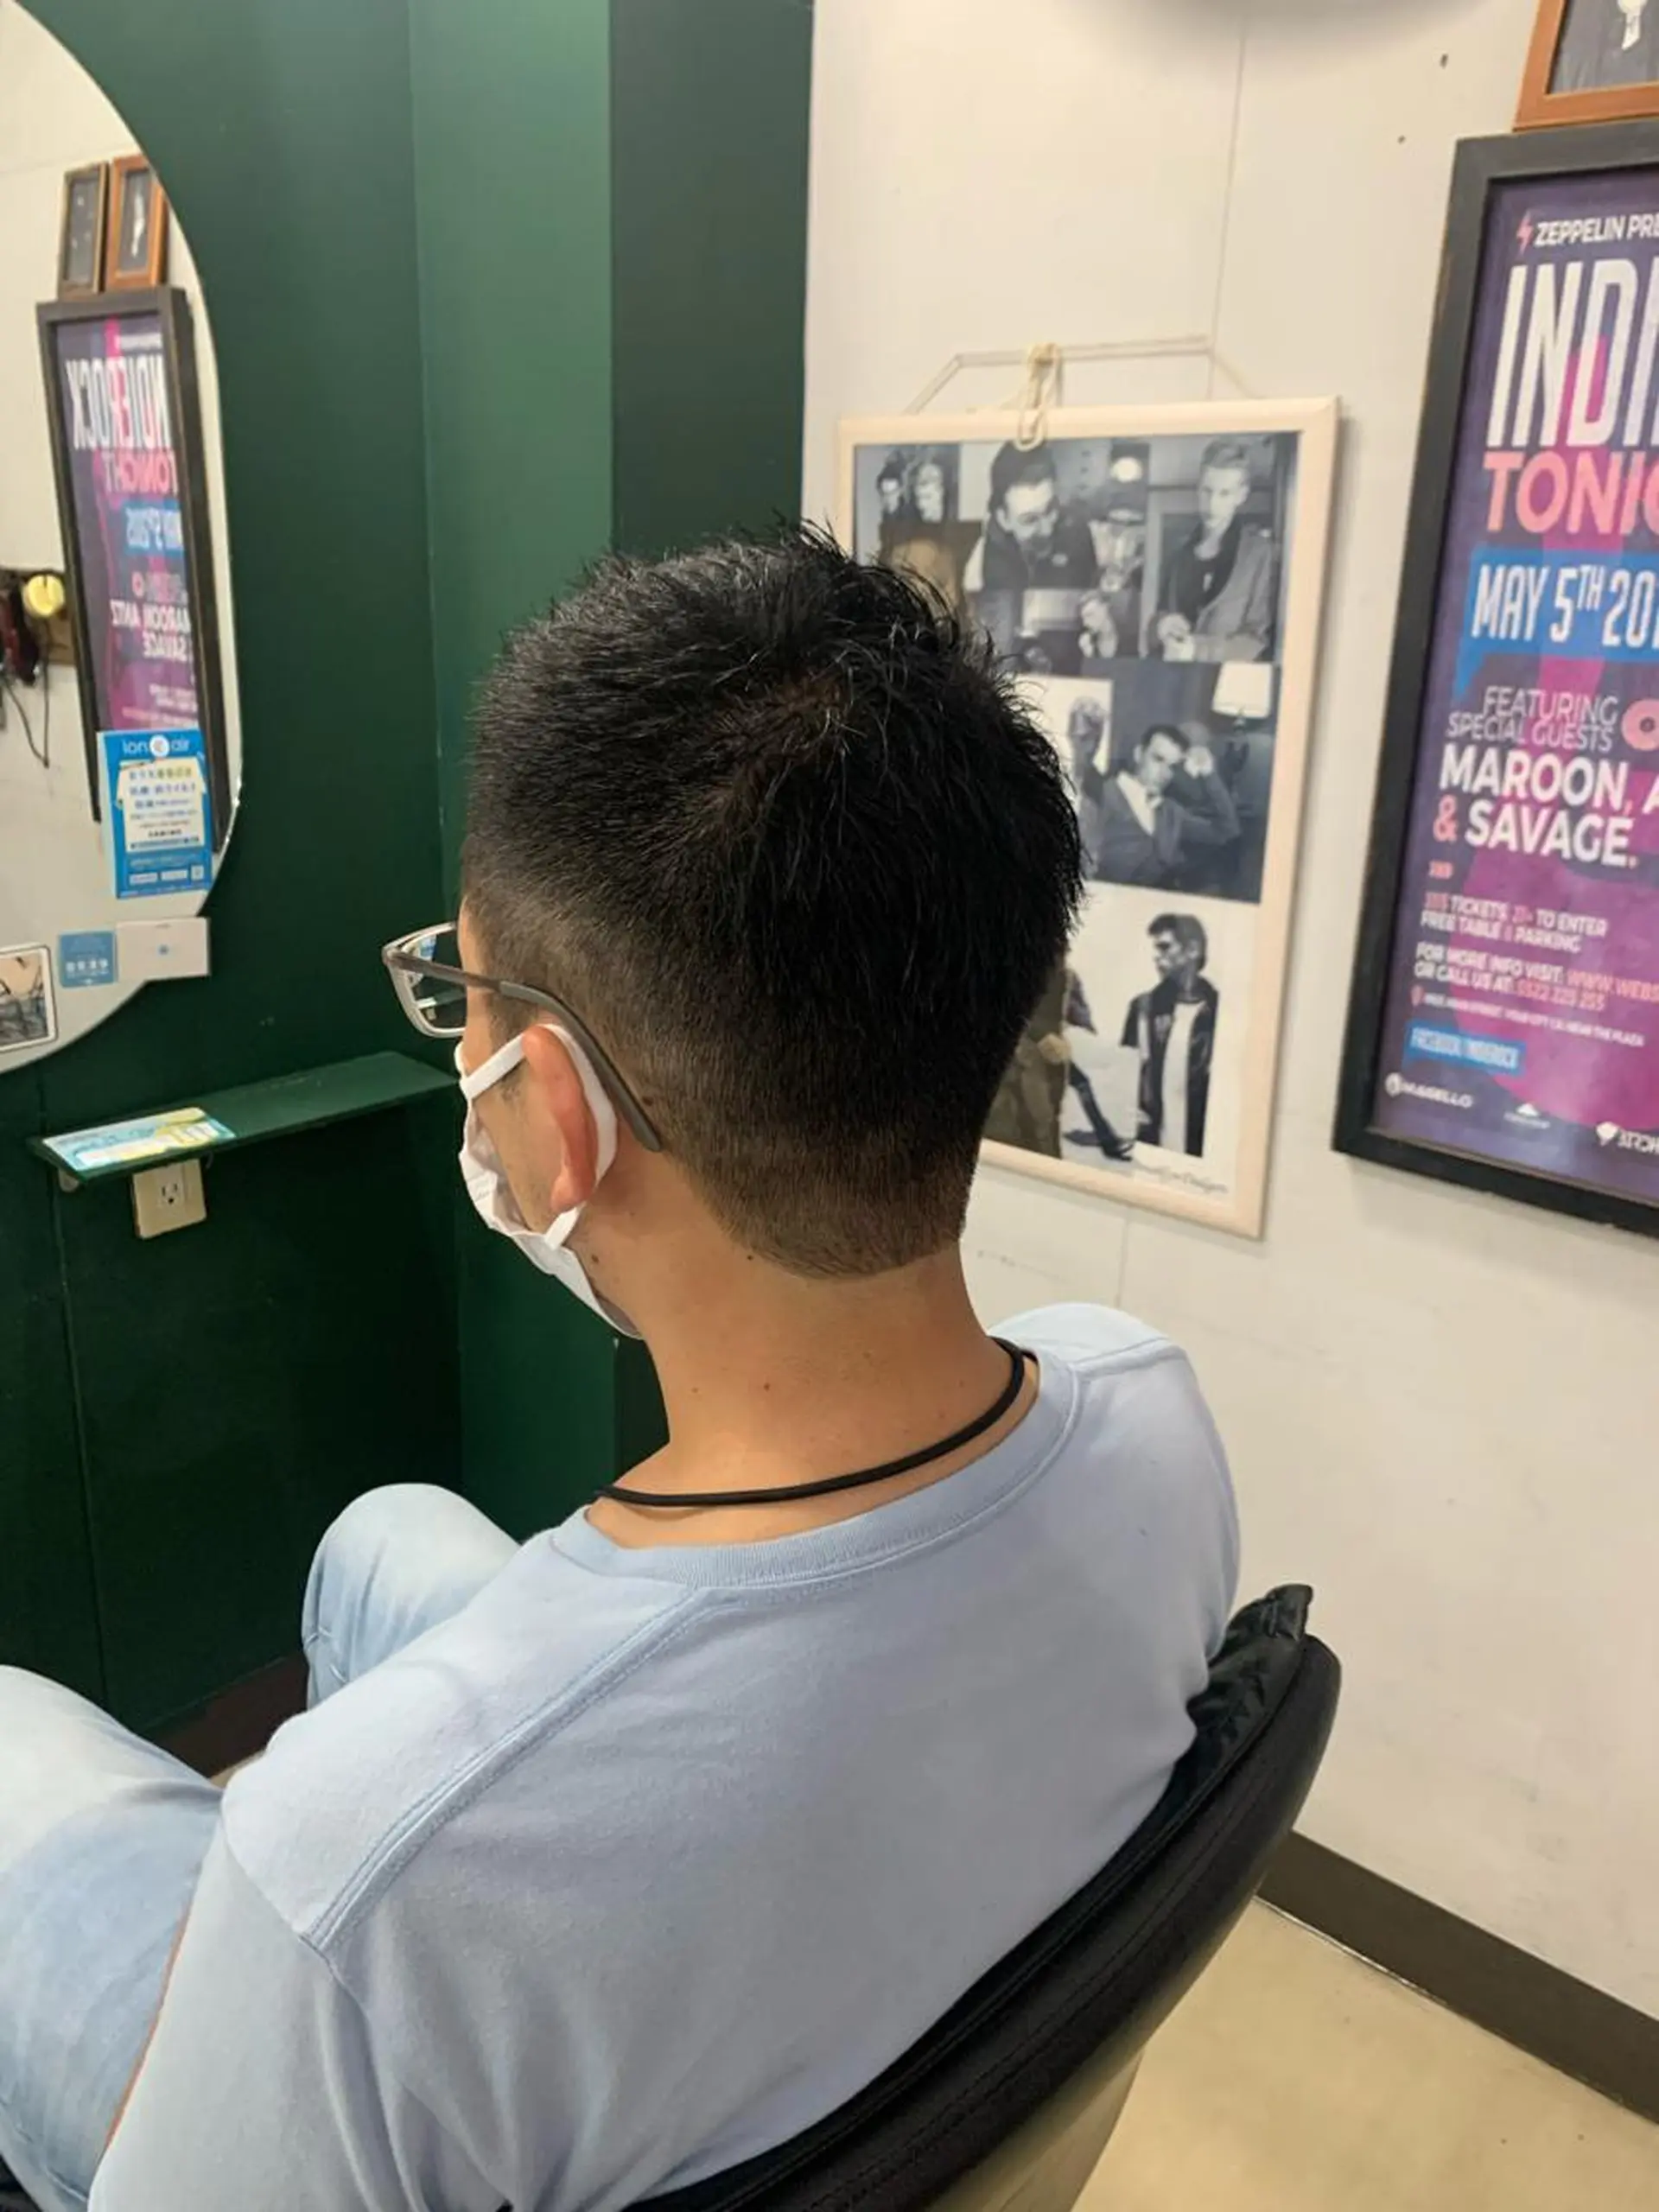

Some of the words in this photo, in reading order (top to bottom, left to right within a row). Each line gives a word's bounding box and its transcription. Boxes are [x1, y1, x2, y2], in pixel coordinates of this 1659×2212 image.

[1534, 215, 1626, 246] ZEPPELIN
[1485, 255, 1659, 448] INDI
[1483, 449, 1659, 535] TONI
[1471, 563, 1550, 641] MAY
[1549, 564, 1605, 643] 5TH
[1482, 685, 1619, 727] FEATURING
[1446, 710, 1528, 745] SPECIAL
[1530, 718, 1615, 753] GUESTS
[1439, 741, 1633, 817] MAROON,
[1433, 794, 1459, 842] &
[1464, 798, 1639, 869] SAVAGE.
[1421, 910, 1457, 932] FREE
[1514, 925, 1581, 954] PARKING
[1450, 894, 1510, 922] TICKETS
[1535, 908, 1556, 929] TO
[1556, 912, 1609, 938] ENTER
[1413, 959, 1435, 978] OR
[1435, 963, 1470, 986] CALL
[1470, 969, 1492, 990] US
[1415, 941, 1445, 962] FOR
[1488, 954, 1523, 976] INFO
